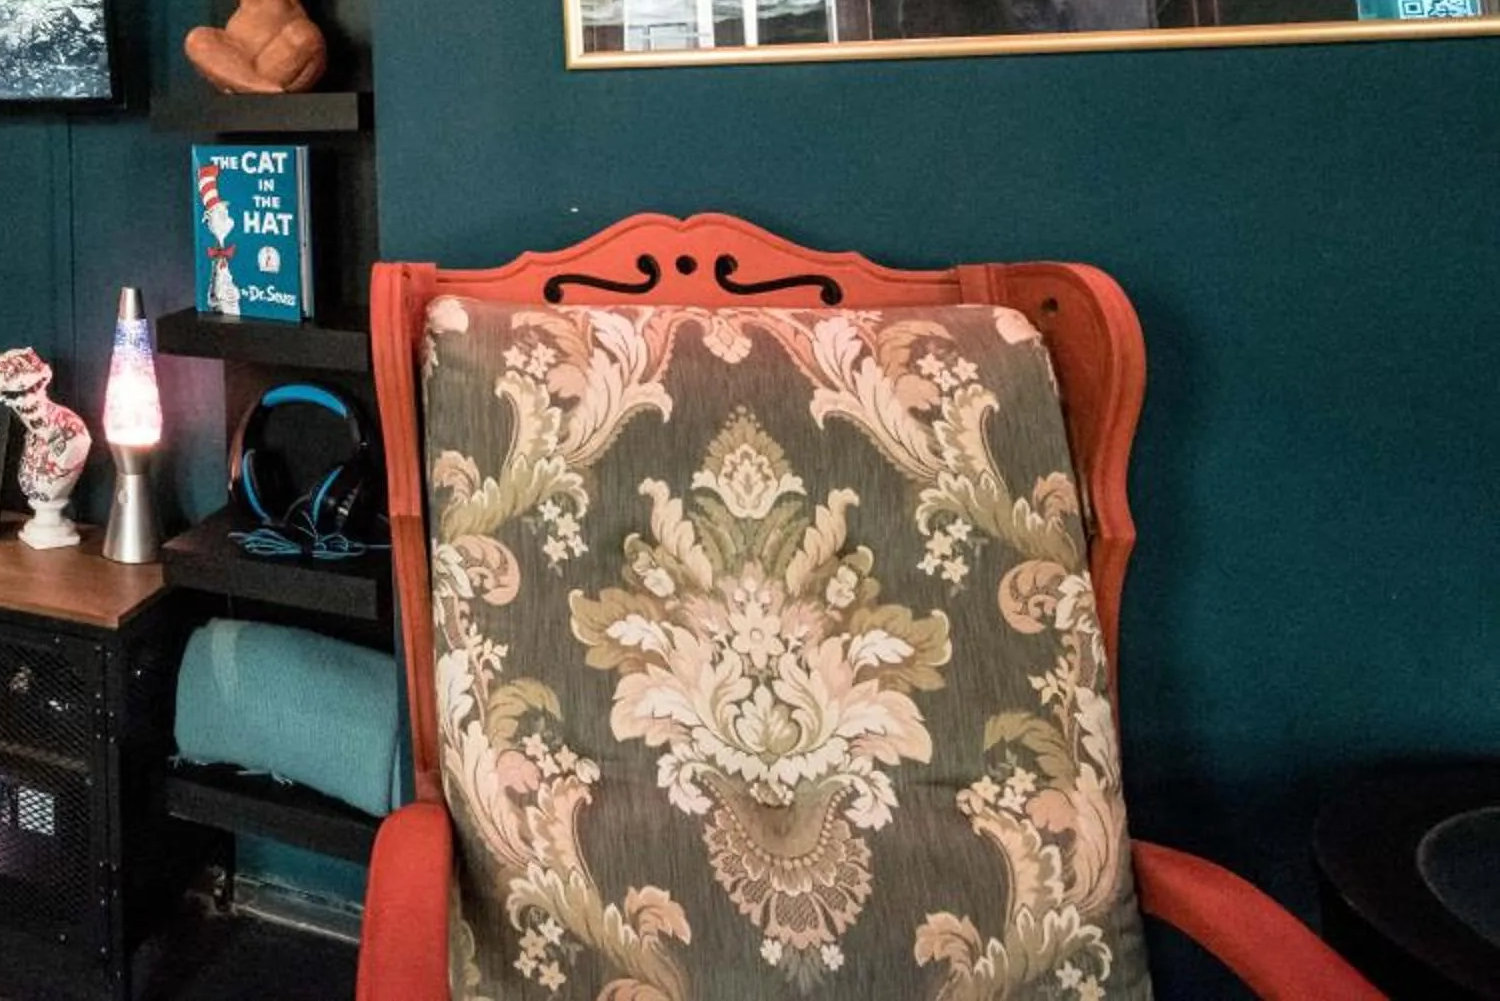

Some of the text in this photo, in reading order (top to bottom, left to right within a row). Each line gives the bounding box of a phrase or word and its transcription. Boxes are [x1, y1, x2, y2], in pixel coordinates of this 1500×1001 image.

[210, 150, 288, 174] THE CAT
[258, 178, 275, 191] IN
[253, 196, 281, 208] THE
[243, 211, 294, 236] HAT
